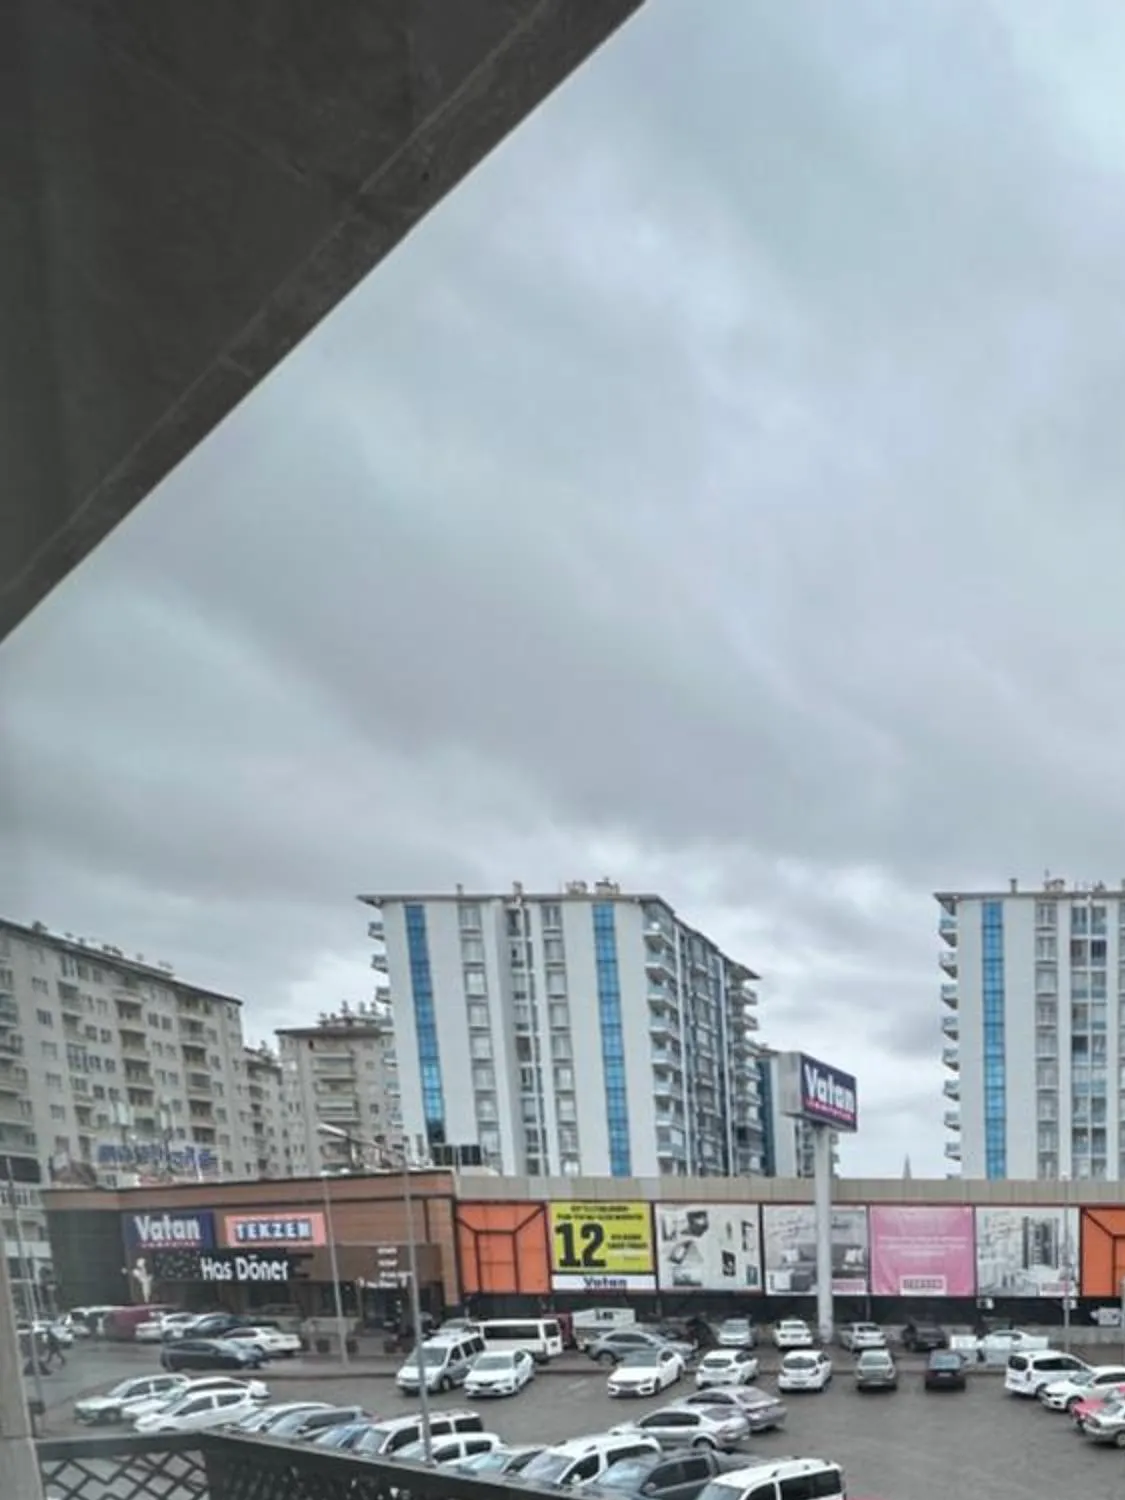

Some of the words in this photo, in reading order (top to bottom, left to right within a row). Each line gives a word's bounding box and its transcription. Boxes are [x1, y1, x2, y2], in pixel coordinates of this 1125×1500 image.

[134, 1215, 200, 1241] Vatan
[555, 1222, 607, 1267] 12
[201, 1258, 232, 1280] Has
[235, 1254, 288, 1281] Döner
